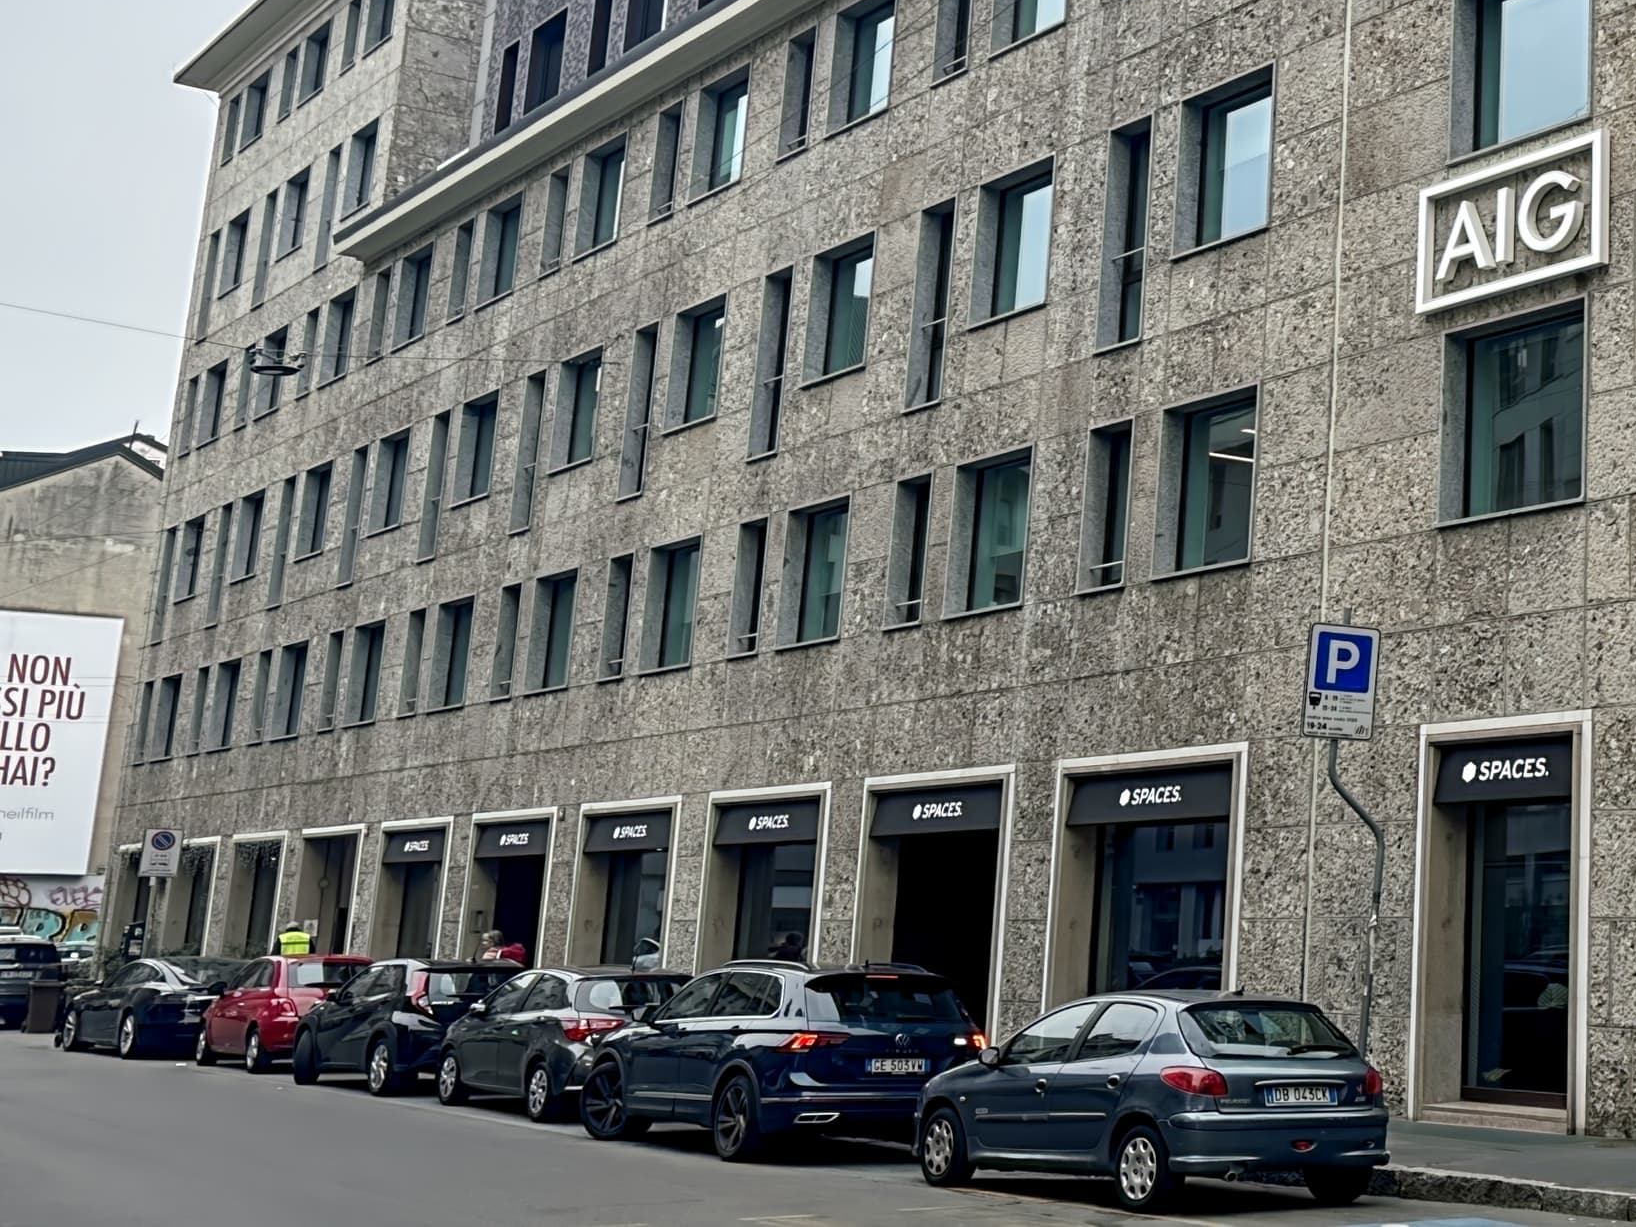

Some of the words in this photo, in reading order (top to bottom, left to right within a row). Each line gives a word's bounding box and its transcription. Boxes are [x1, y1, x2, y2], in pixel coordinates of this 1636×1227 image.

[1435, 170, 1585, 282] AIG
[7, 653, 72, 686] NON
[1326, 639, 1360, 684] P
[38, 682, 86, 720] PIÙ
[1478, 757, 1549, 781] SPACES.
[1130, 785, 1182, 805] SPACES.
[921, 802, 963, 819] SPACES.
[1274, 1087, 1289, 1101] DB
[1294, 1086, 1329, 1101] 043CK
